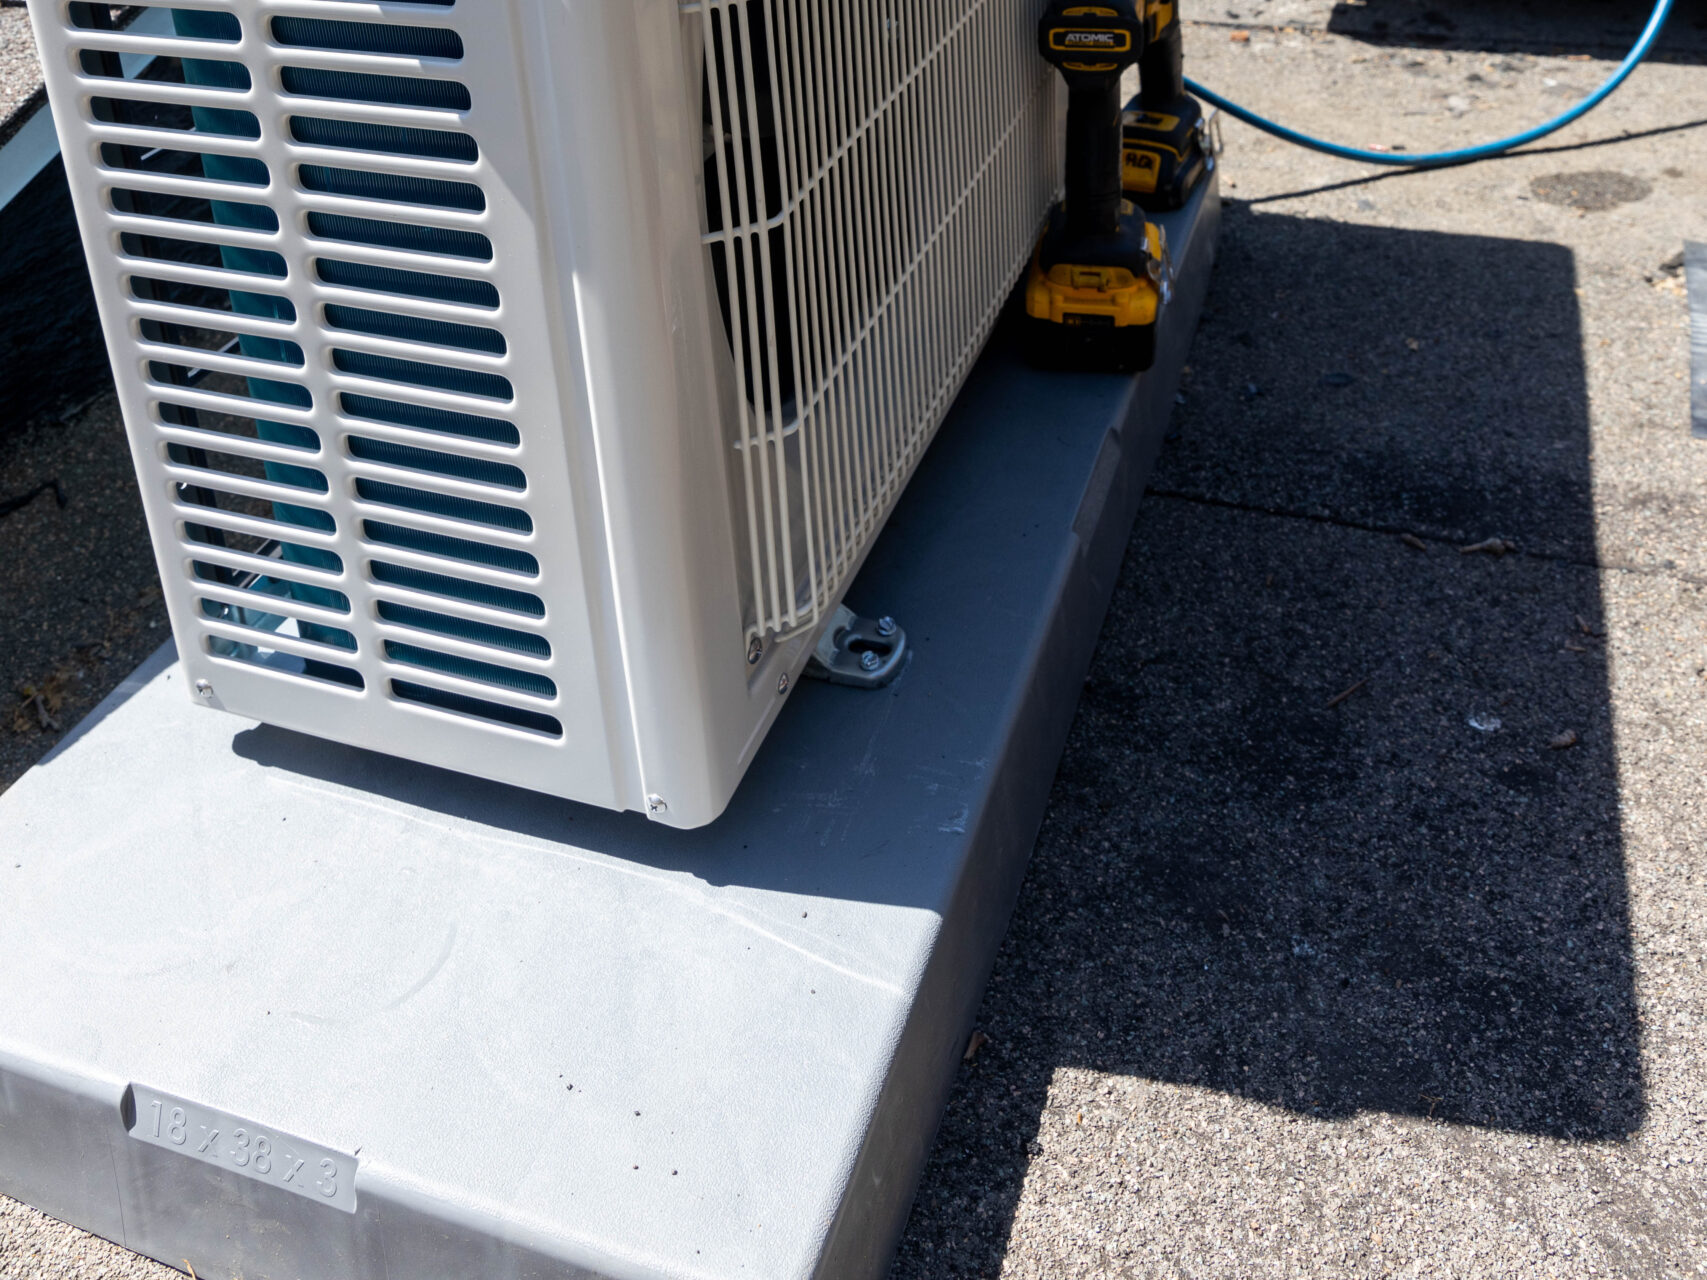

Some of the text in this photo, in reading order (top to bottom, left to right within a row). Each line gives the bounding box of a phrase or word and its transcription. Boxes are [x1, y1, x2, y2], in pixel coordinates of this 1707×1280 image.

[1065, 33, 1114, 42] ATOMIC
[150, 1099, 187, 1146] 18
[229, 1127, 272, 1175] 38
[315, 1157, 338, 1198] 3
